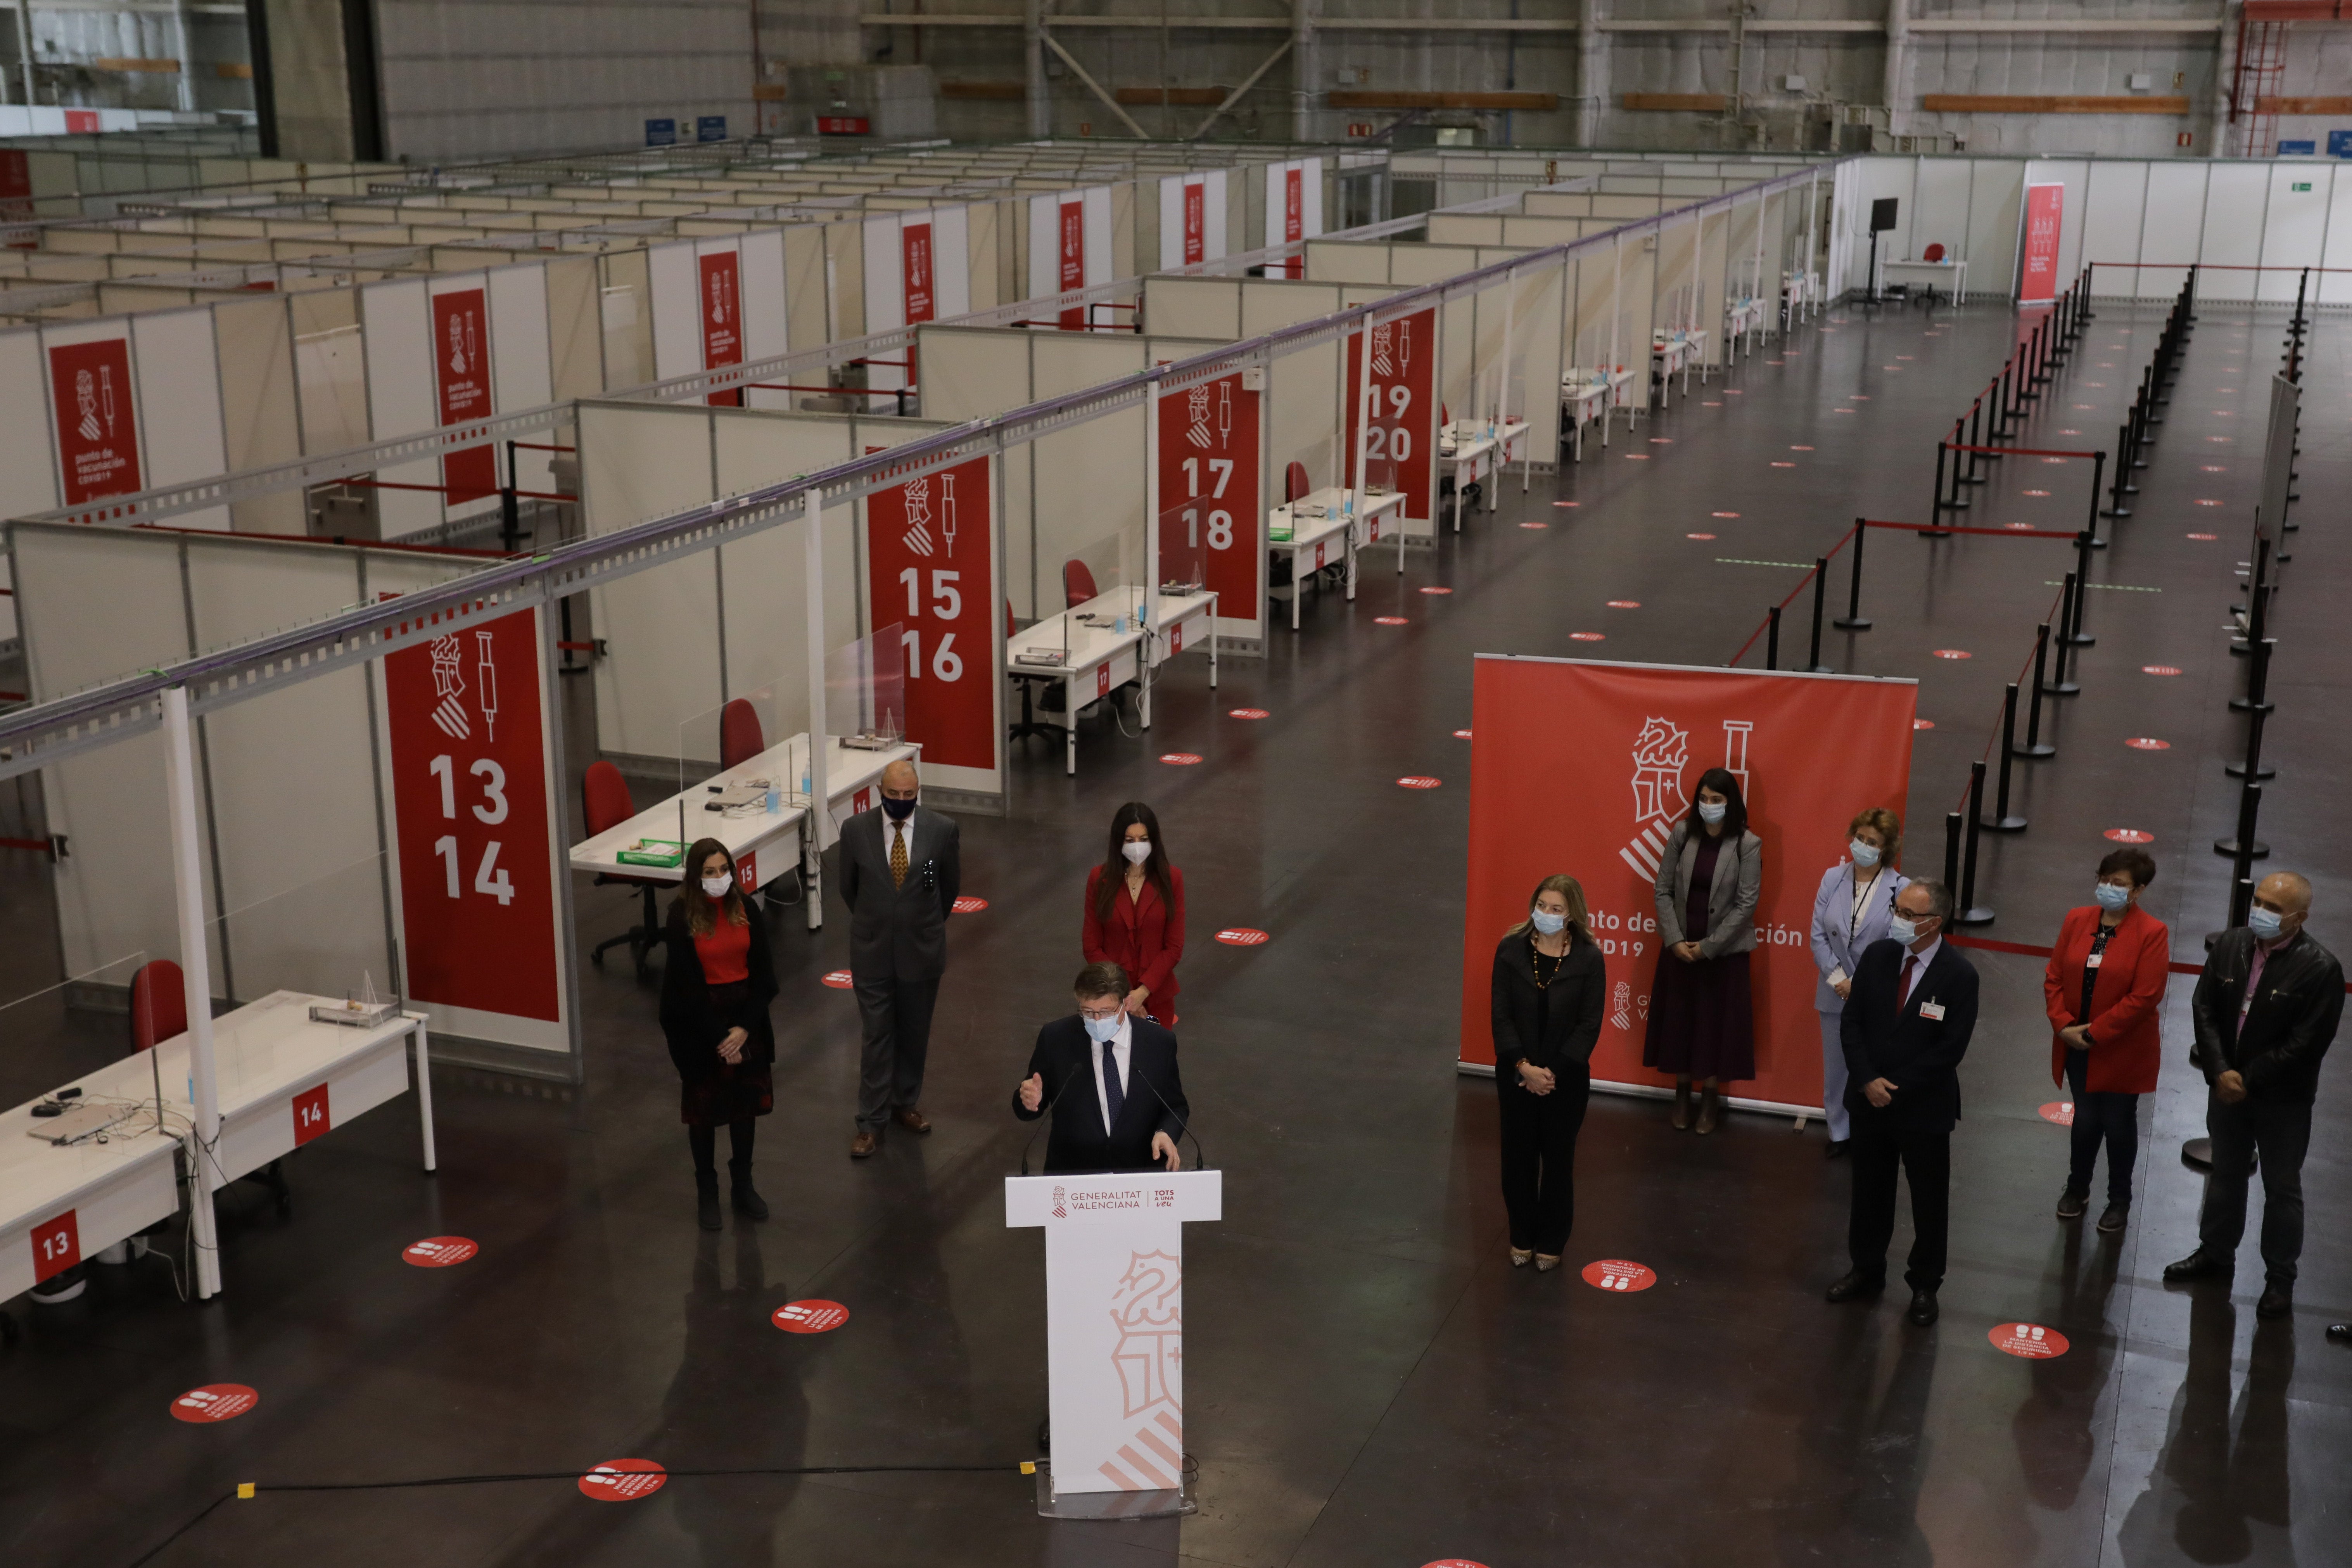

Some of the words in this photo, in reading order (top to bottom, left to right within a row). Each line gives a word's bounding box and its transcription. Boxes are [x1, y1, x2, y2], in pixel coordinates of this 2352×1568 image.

[1370, 384, 1411, 418] 19
[1367, 426, 1411, 462] 20
[1182, 457, 1234, 499] 17
[1182, 508, 1234, 550] 18
[899, 567, 961, 620] 15
[901, 630, 963, 682] 16
[1100, 671, 1107, 686] 17
[430, 754, 508, 825] 13
[857, 799, 867, 813] 16
[434, 835, 515, 906] 14
[741, 864, 752, 884] 15
[1628, 912, 1656, 932] de
[301, 1102, 322, 1127] 14
[1071, 1191, 1141, 1200] GENERALITAT
[1072, 1201, 1140, 1210] VALENCIANA
[43, 1231, 68, 1260] 13
[2010, 1338, 2046, 1346] MANTENGA
